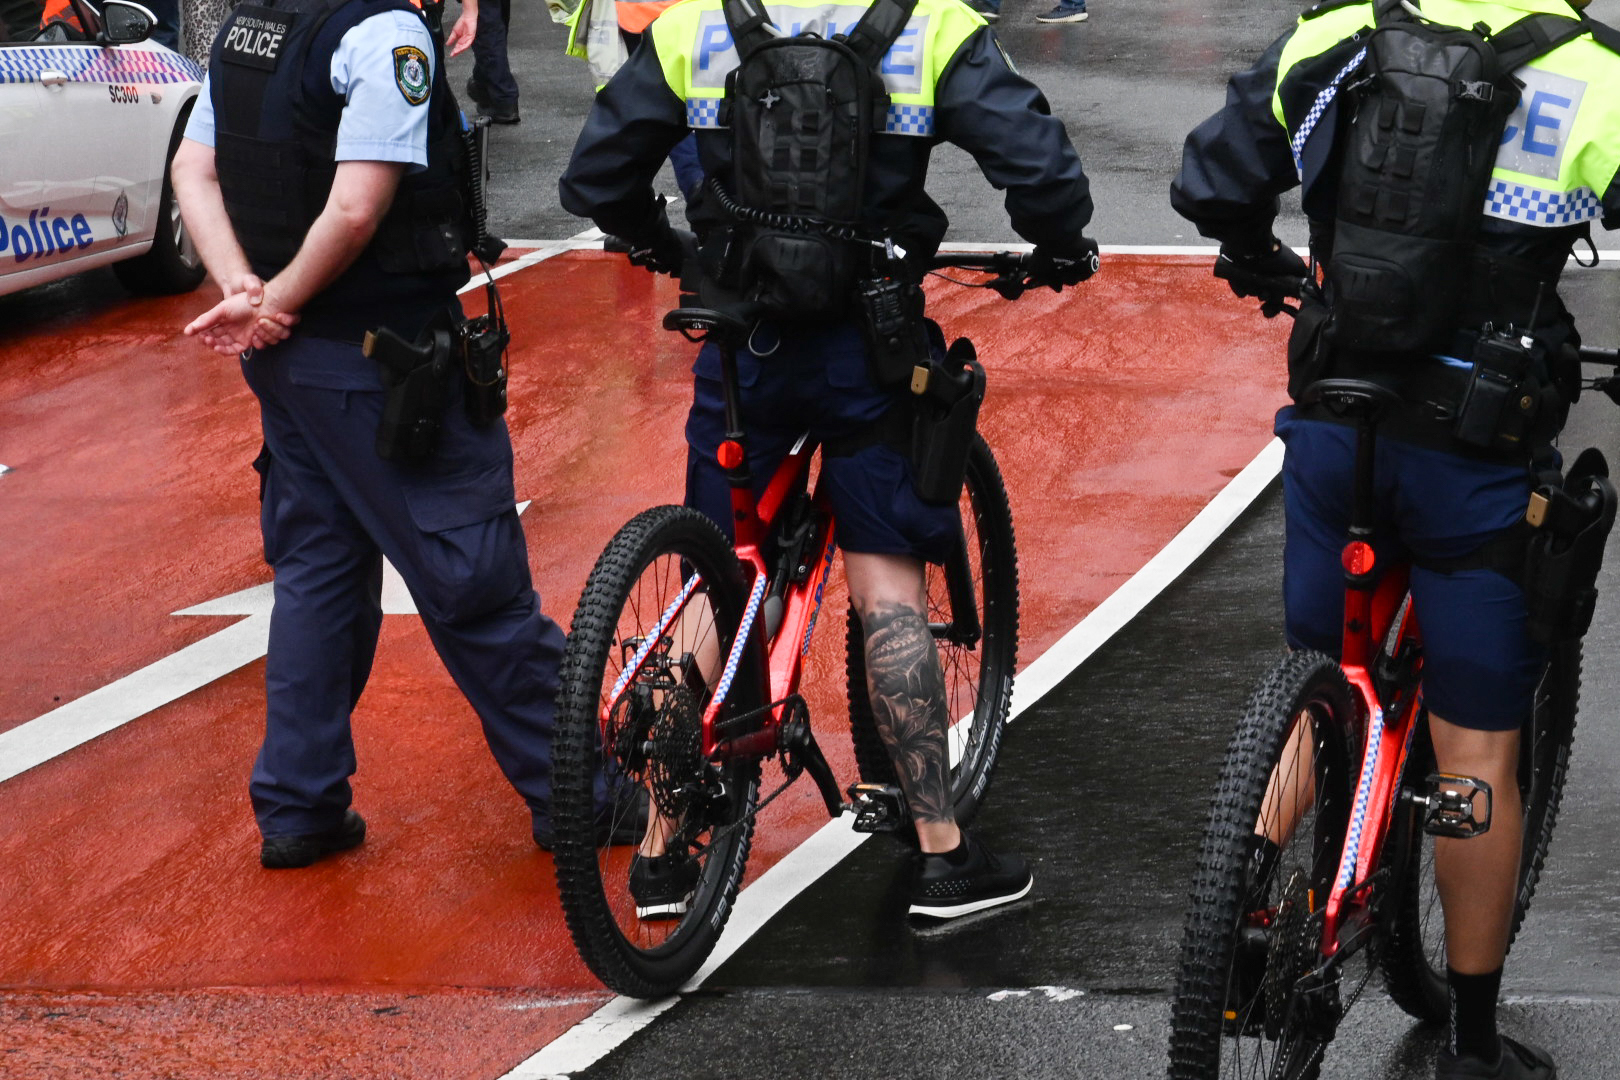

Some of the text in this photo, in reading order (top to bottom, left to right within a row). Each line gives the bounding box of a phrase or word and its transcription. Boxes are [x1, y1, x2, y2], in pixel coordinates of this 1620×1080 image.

[235, 16, 287, 34] NEW SOUTH WALES
[224, 25, 283, 59] POLICE
[108, 84, 139, 104] SC300
[972, 674, 1012, 801] SCHWALBE
